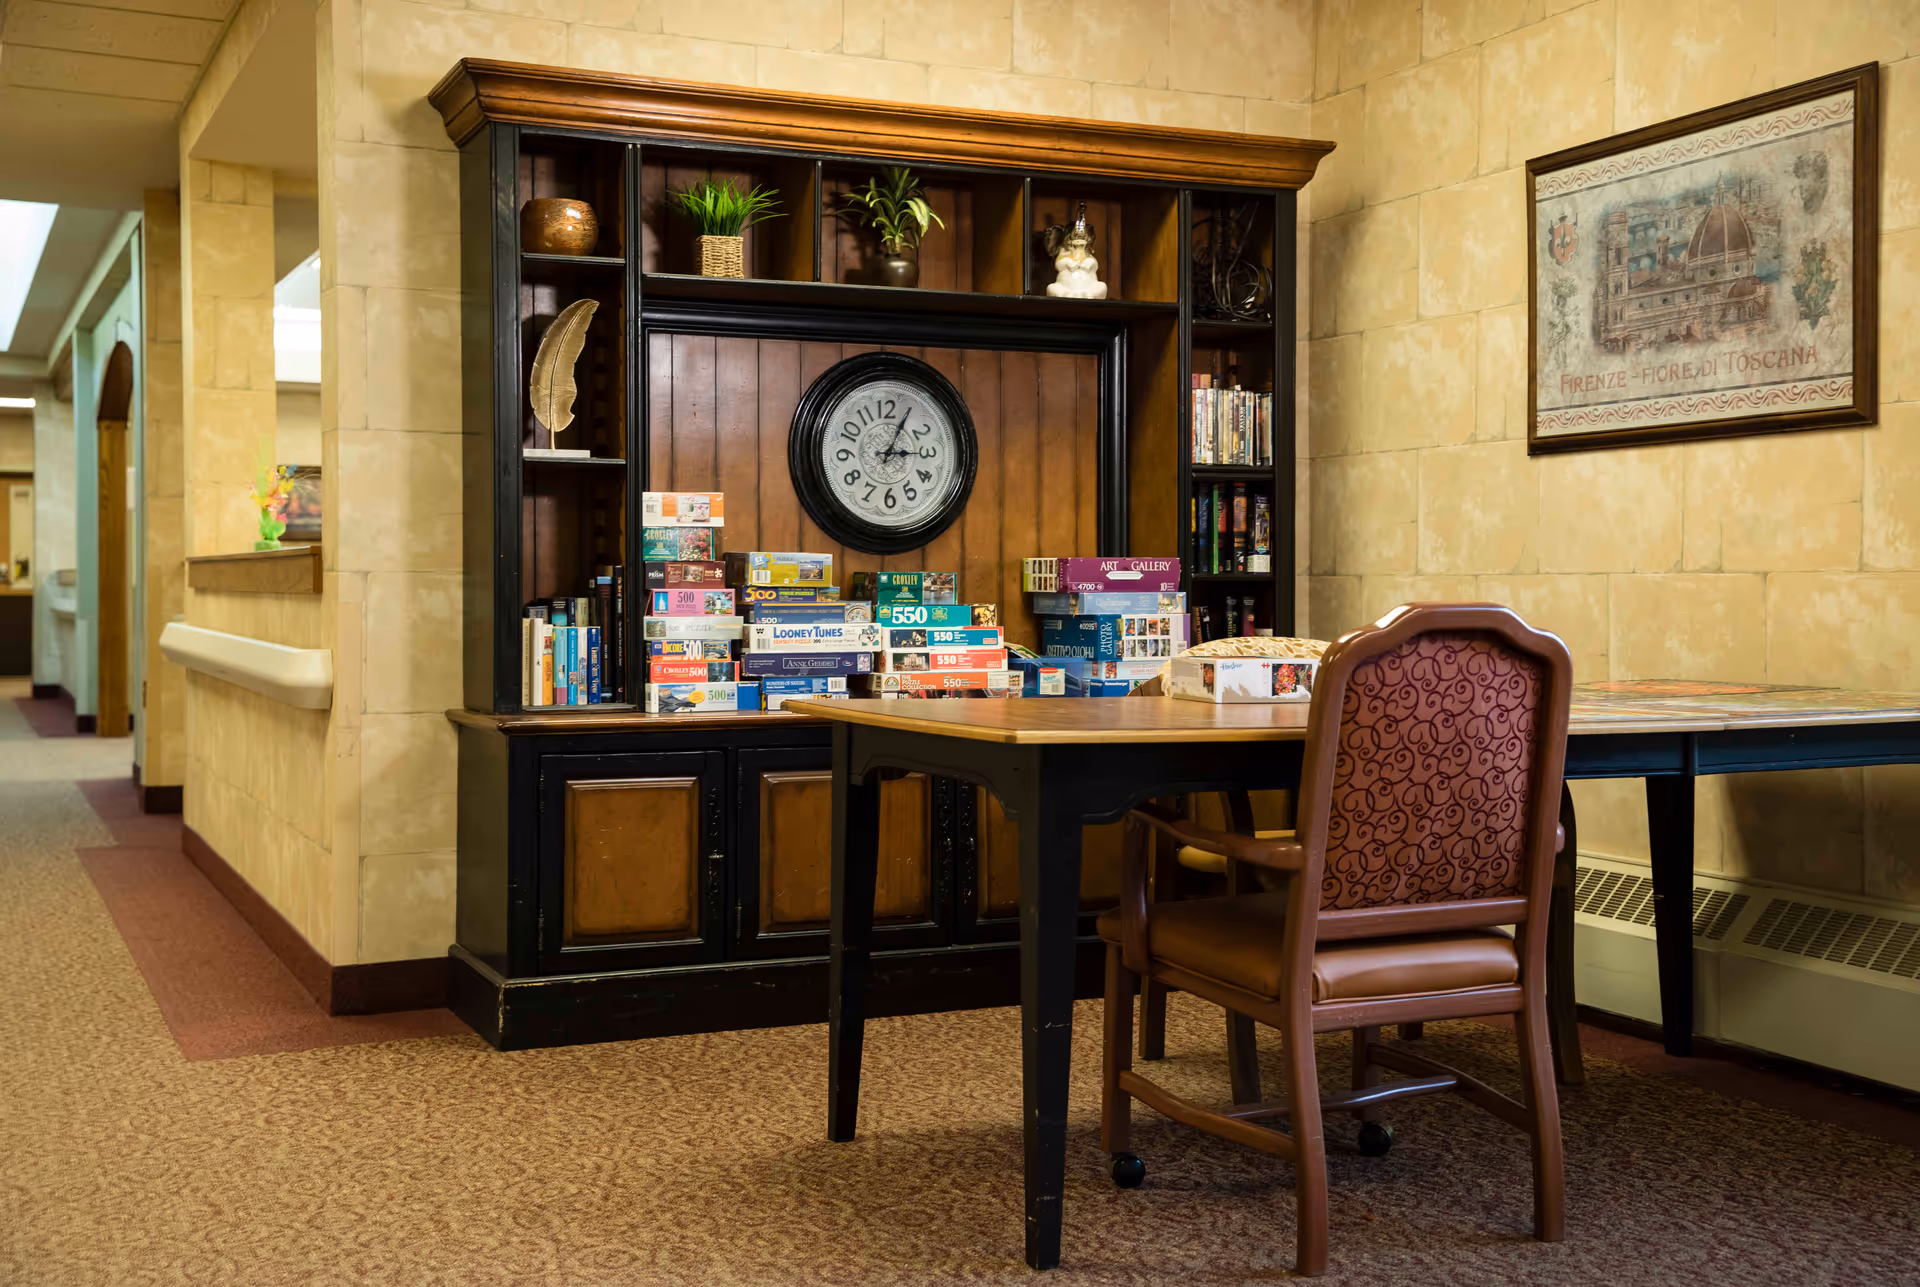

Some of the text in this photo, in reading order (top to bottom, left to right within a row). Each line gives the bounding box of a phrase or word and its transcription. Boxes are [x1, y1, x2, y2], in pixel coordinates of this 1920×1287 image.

[1641, 361, 1694, 386] FIORE
[1701, 357, 1718, 377] DI
[1726, 344, 1818, 374] TOSCANA
[857, 404, 874, 426] 11
[877, 399, 896, 419] 12
[840, 421, 861, 443] 10
[912, 423, 931, 441] 2
[836, 448, 856, 462] 9
[919, 445, 937, 460] 3
[844, 469, 861, 486] 8
[916, 468, 933, 484] 4
[861, 481, 877, 502] 7
[884, 487, 897, 509] 6
[903, 480, 917, 501] 5
[1100, 561, 1171, 571] ART GALLERY
[745, 587, 777, 601] 500
[1078, 583, 1095, 591] 4700
[677, 591, 694, 603] 500
[892, 606, 928, 624] 550
[773, 625, 843, 638] LOONEY TUNES
[933, 631, 953, 641] 550
[683, 640, 702, 661] 500
[937, 655, 957, 665] 550
[688, 667, 707, 677] 500
[943, 678, 962, 688] 550
[708, 690, 726, 701] 500
